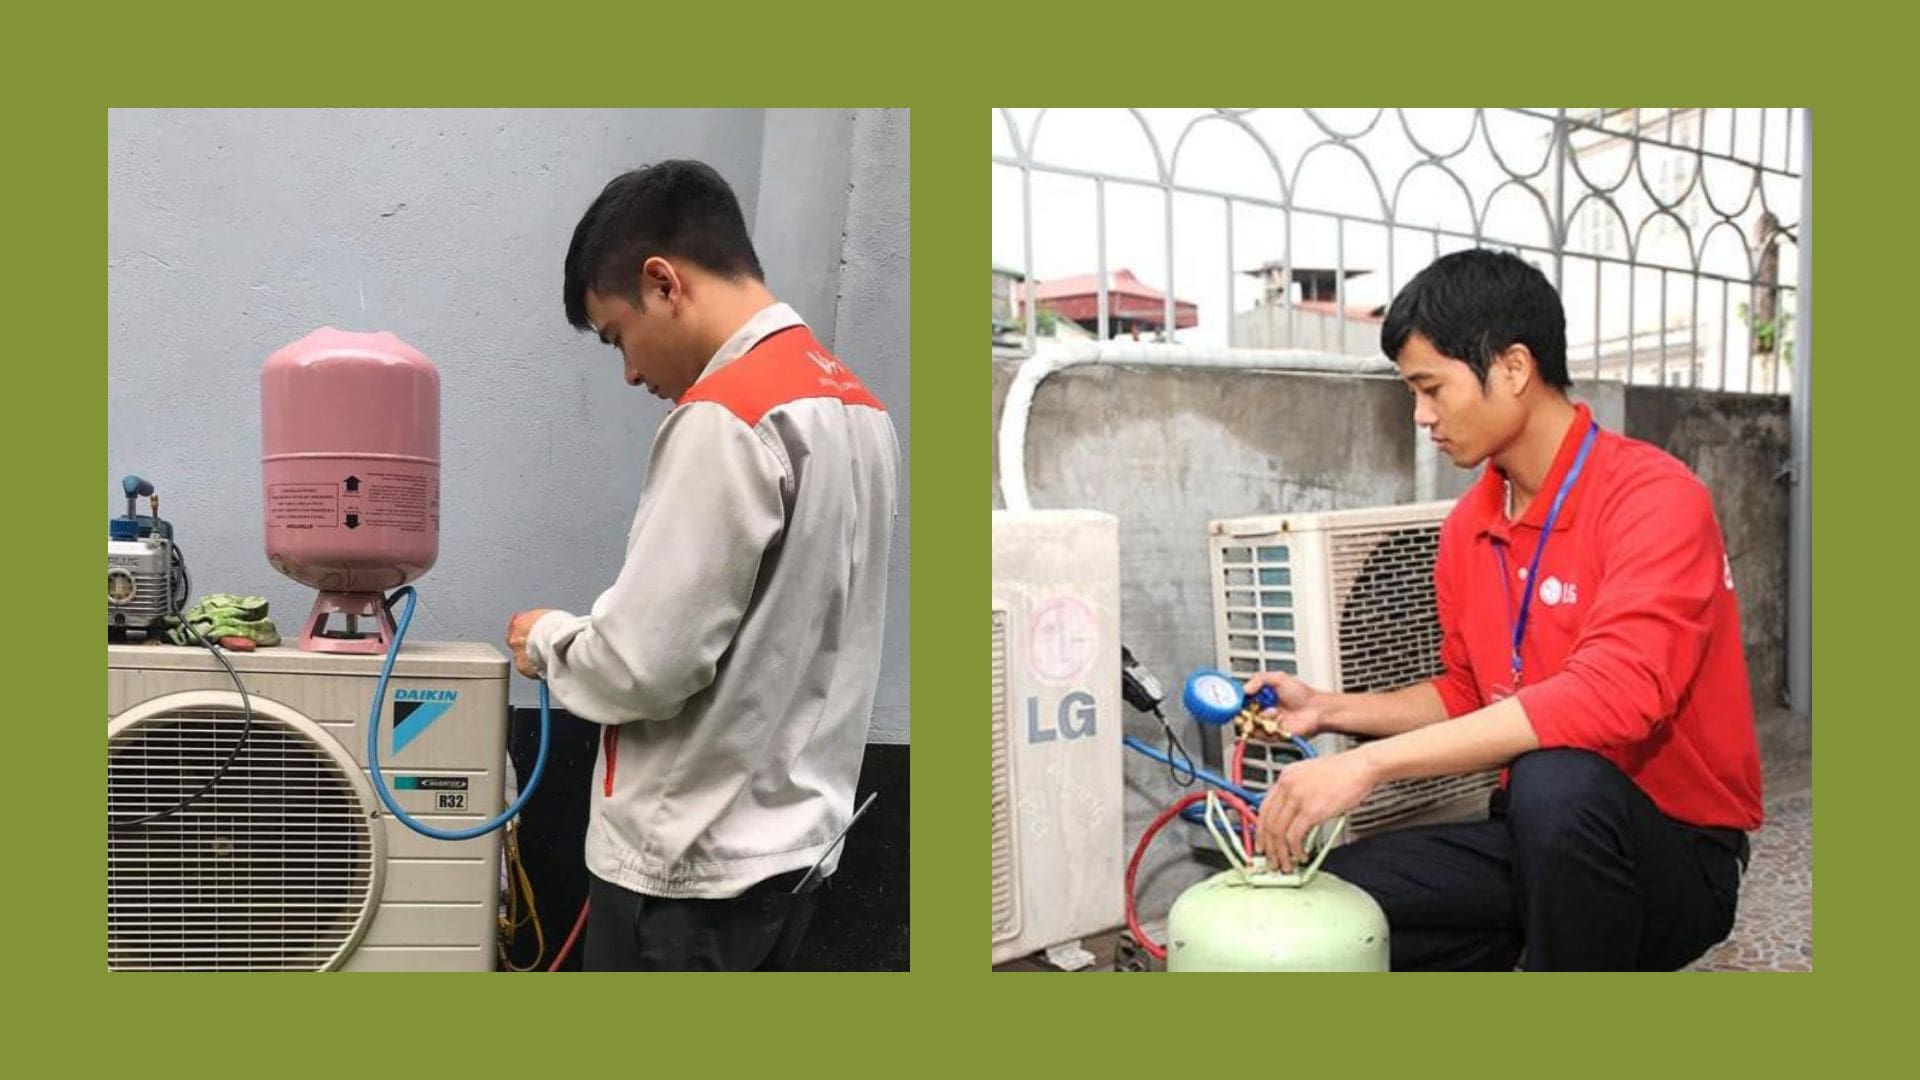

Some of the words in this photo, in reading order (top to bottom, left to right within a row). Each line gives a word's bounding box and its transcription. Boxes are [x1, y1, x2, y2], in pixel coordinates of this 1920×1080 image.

[1562, 582, 1578, 604] LG
[394, 688, 458, 701] DAIKIN
[1027, 691, 1097, 745] LG
[438, 794, 465, 808] R32
